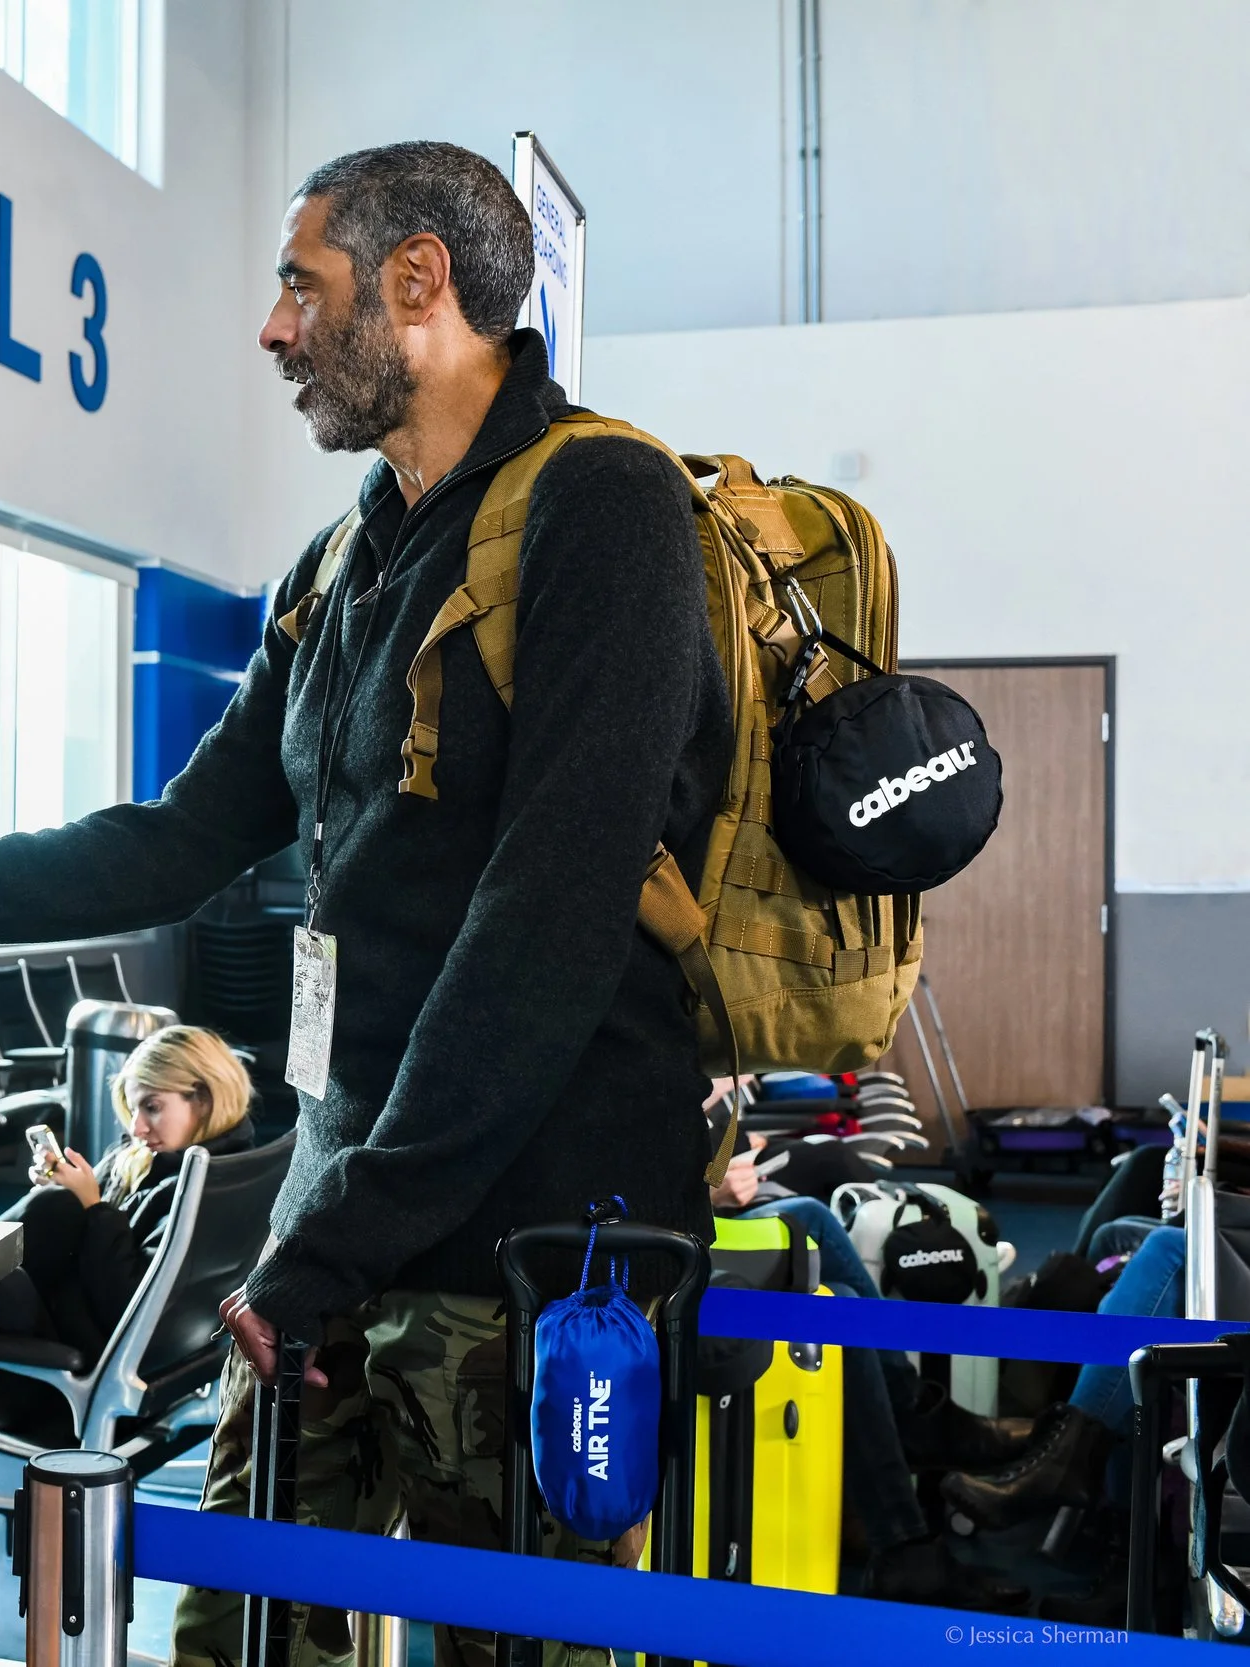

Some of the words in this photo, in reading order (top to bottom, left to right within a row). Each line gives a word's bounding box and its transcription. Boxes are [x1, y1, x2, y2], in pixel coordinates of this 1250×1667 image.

[536, 184, 566, 248] GENERAL
[68, 252, 108, 413] 3
[588, 1434, 609, 1481] AIR
